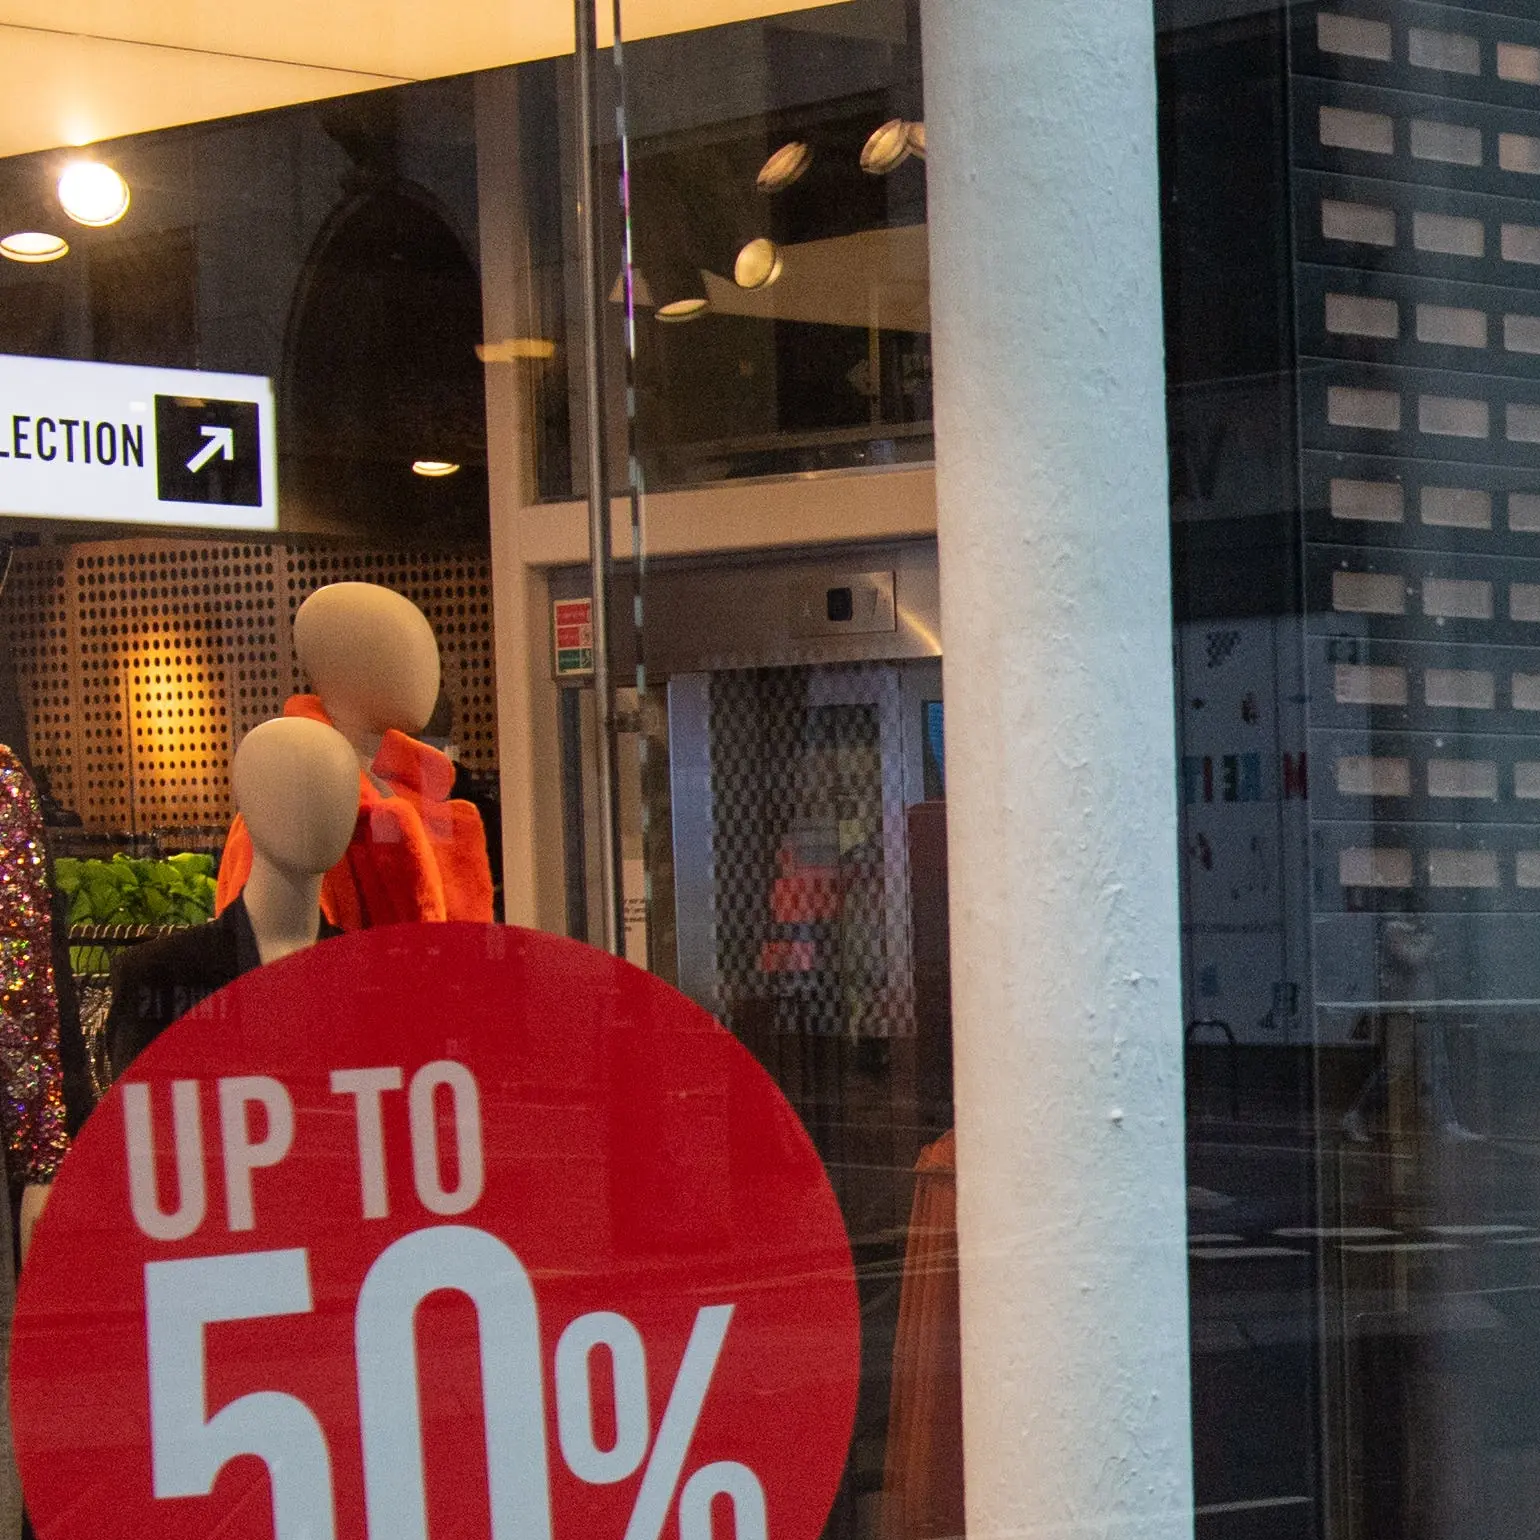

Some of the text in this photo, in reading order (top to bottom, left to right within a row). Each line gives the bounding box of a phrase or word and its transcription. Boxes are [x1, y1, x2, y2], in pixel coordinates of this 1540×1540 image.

[0, 415, 144, 467] ECTION
[122, 1060, 486, 1242] UP TO
